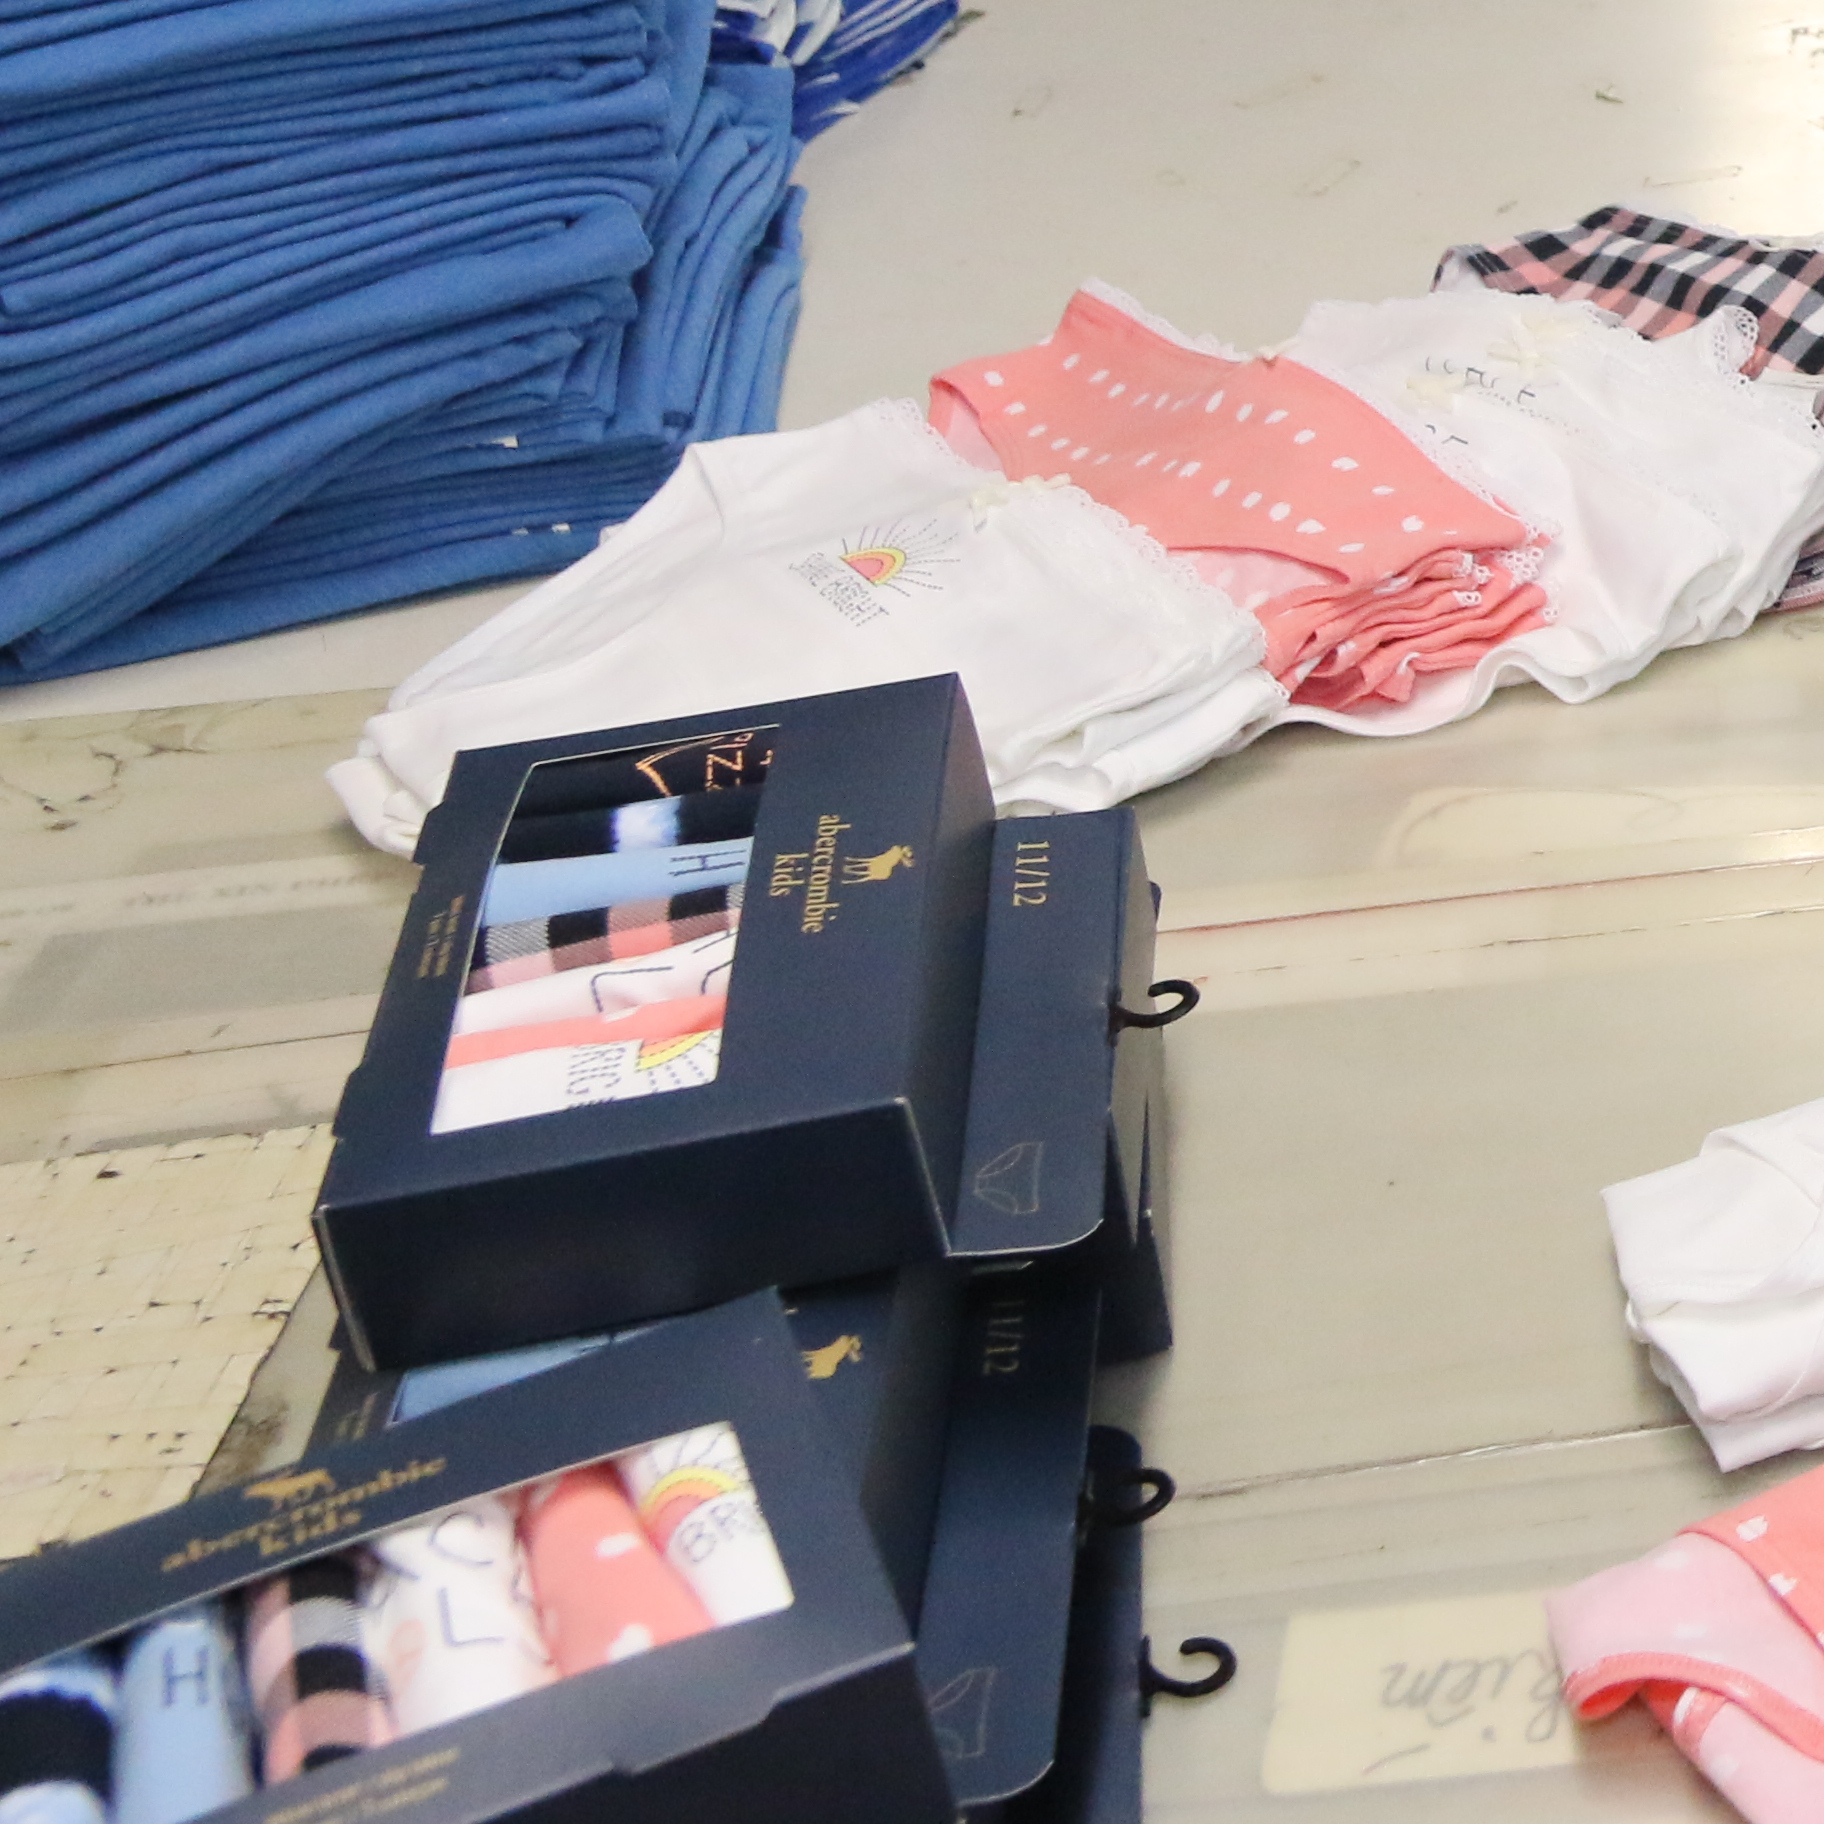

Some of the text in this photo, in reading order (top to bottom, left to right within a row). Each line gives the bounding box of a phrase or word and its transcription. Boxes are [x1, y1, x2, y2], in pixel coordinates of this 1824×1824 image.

[769, 852, 809, 898] kids
[801, 812, 852, 935] abercrombie
[1012, 840, 1051, 908] 11/12
[983, 1300, 1025, 1376] 11/12
[160, 1456, 449, 1573] abercrombie
[258, 1509, 363, 1557] kids
[160, 1645, 210, 1708] H
